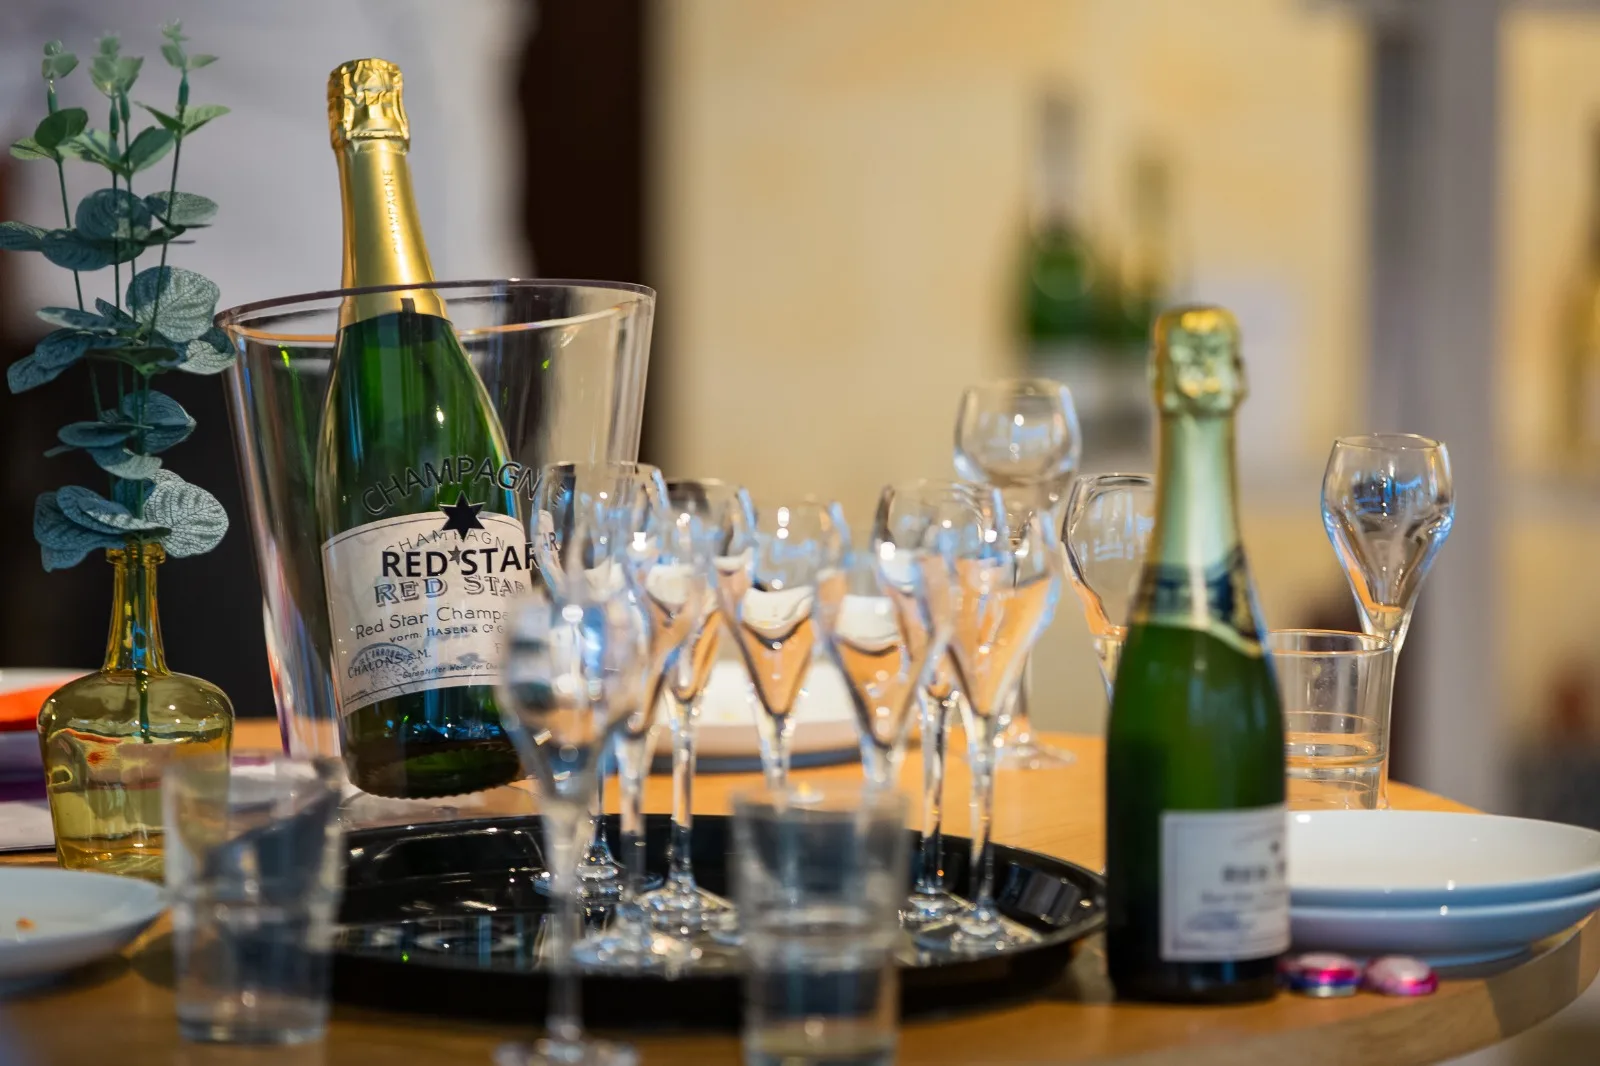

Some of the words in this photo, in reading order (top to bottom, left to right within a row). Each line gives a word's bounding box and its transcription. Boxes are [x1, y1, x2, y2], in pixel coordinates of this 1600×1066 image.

[382, 550, 448, 577] RED
[374, 577, 448, 608] RED
[355, 619, 384, 640] Red
[389, 613, 429, 629] Star
[436, 606, 509, 624] Champa
[389, 632, 422, 643] vorm.
[426, 626, 468, 637] HASEN
